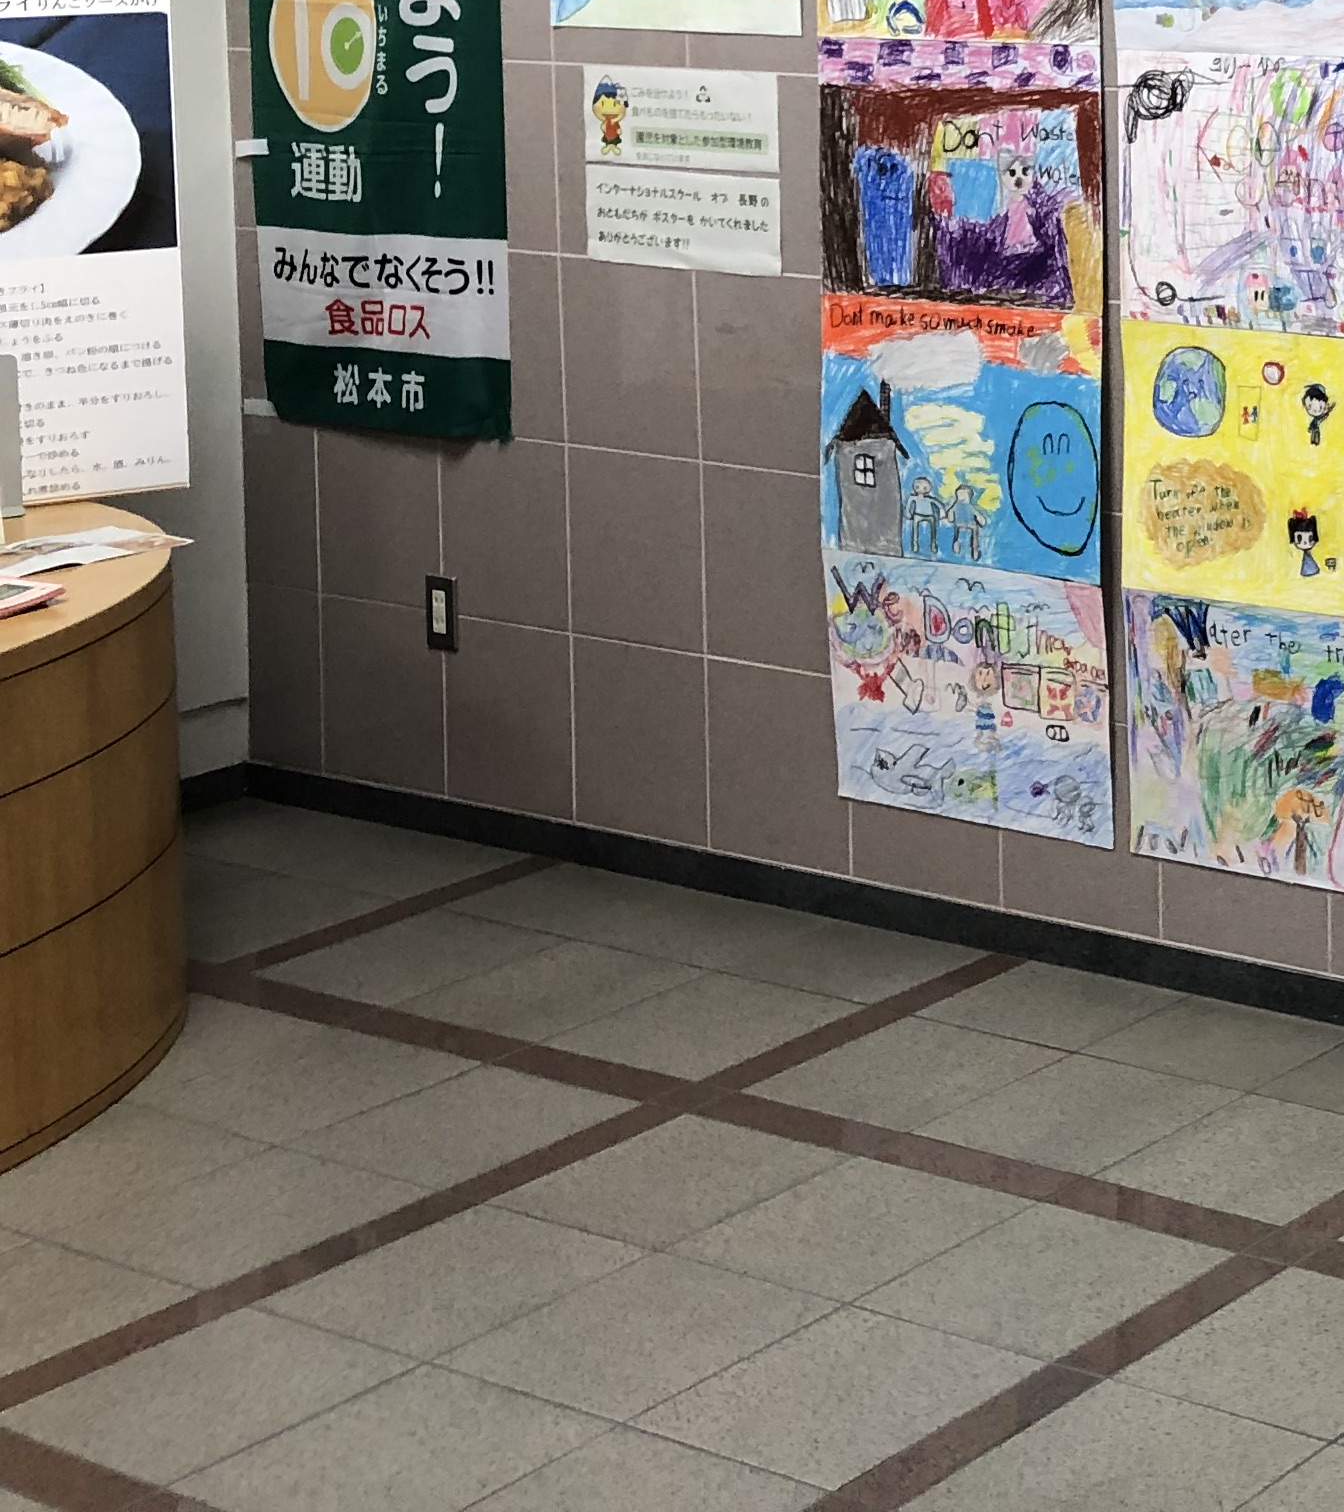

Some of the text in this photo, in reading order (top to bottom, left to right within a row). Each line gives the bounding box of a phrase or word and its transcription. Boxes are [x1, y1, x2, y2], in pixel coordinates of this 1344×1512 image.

[374, 4, 389, 97] いちまる
[291, 141, 363, 203] 運動
[597, 207, 648, 222] おともだちが
[700, 215, 769, 233] かいてくれました
[325, 299, 432, 341] 食品ロス
[868, 309, 916, 329] make
[332, 363, 425, 413] 松本市
[1149, 478, 1180, 501] Turn
[830, 564, 905, 626] We
